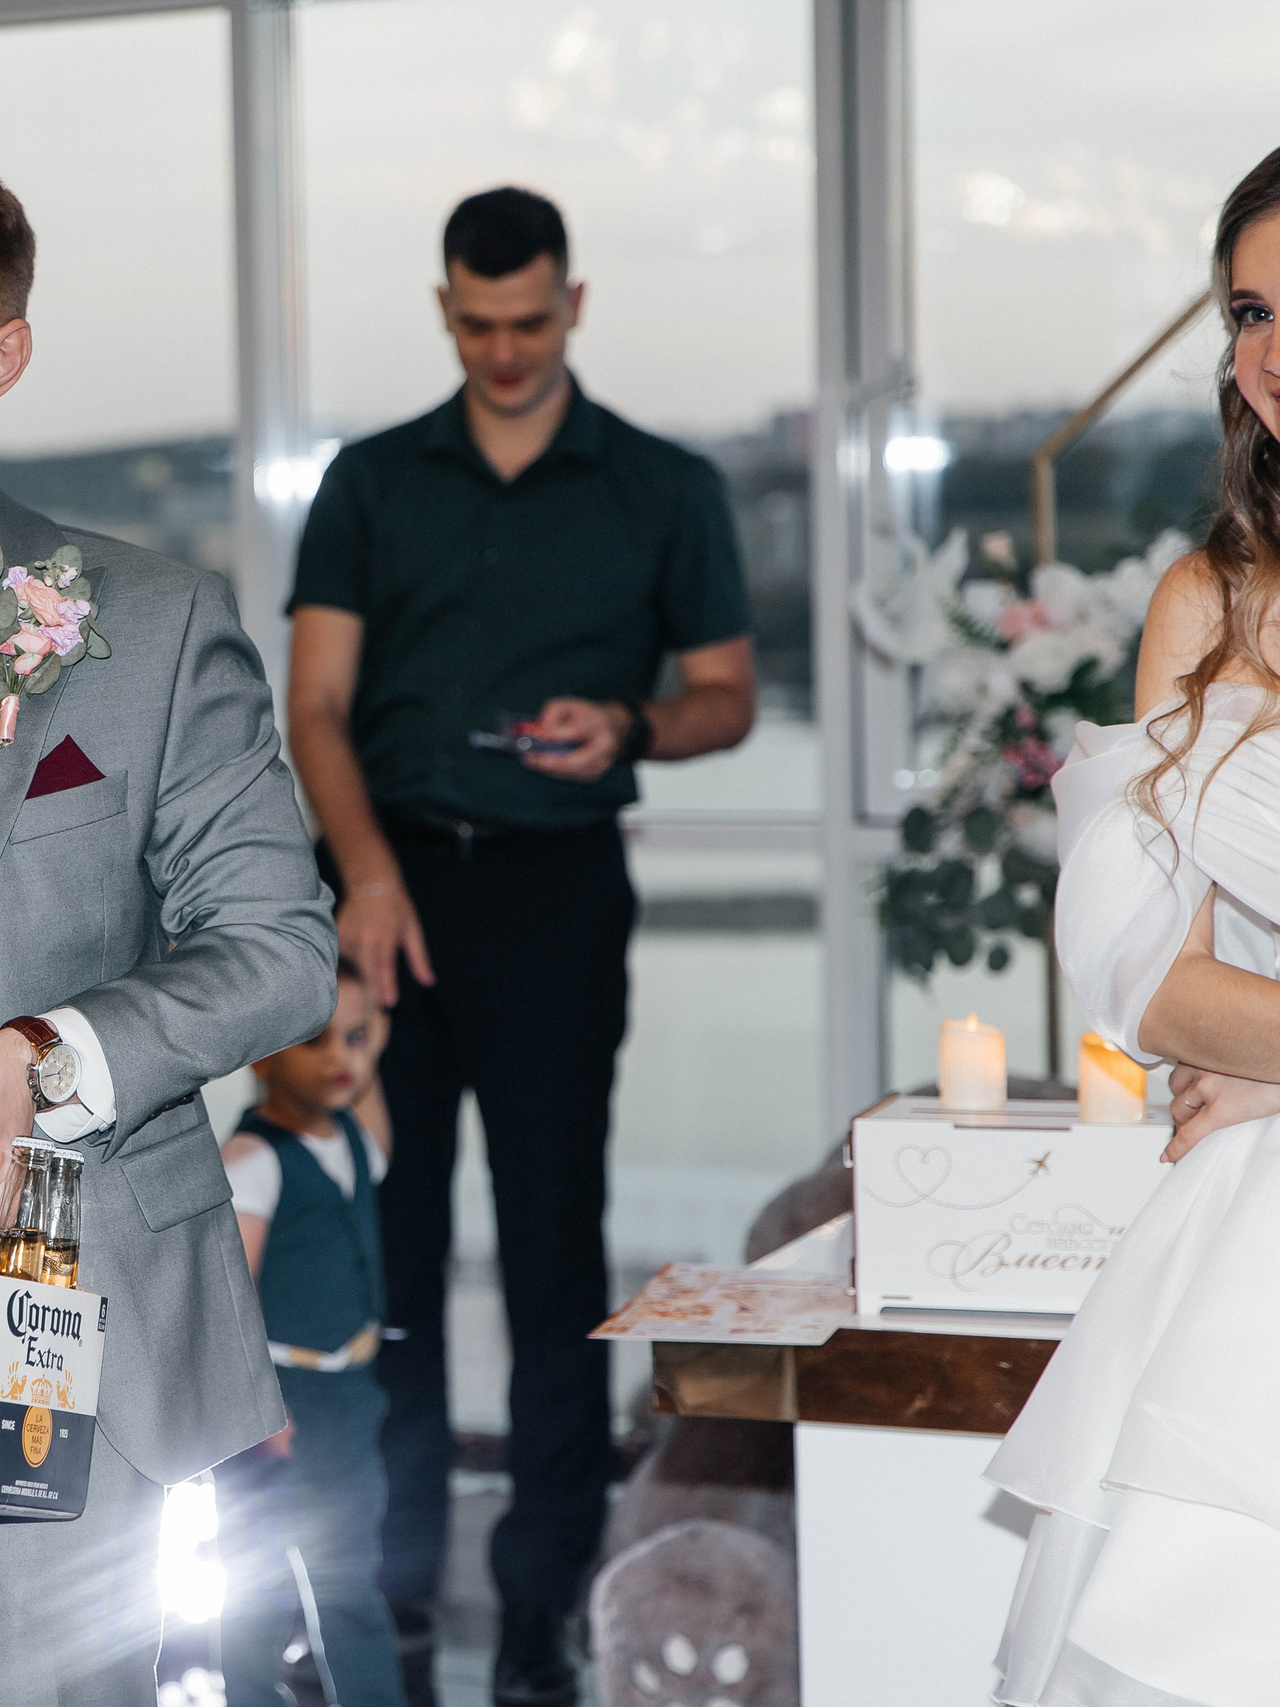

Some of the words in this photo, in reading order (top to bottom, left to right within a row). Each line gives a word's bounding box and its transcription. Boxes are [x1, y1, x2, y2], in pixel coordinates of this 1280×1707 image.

[925, 1229, 1108, 1292] Вмест
[6, 1288, 82, 1341] Corona
[25, 1335, 64, 1372] Extra
[35, 1414, 43, 1422] LA
[26, 1423, 49, 1434] CERVEZA
[31, 1435, 43, 1445] MAS
[30, 1446, 42, 1455] FINA
